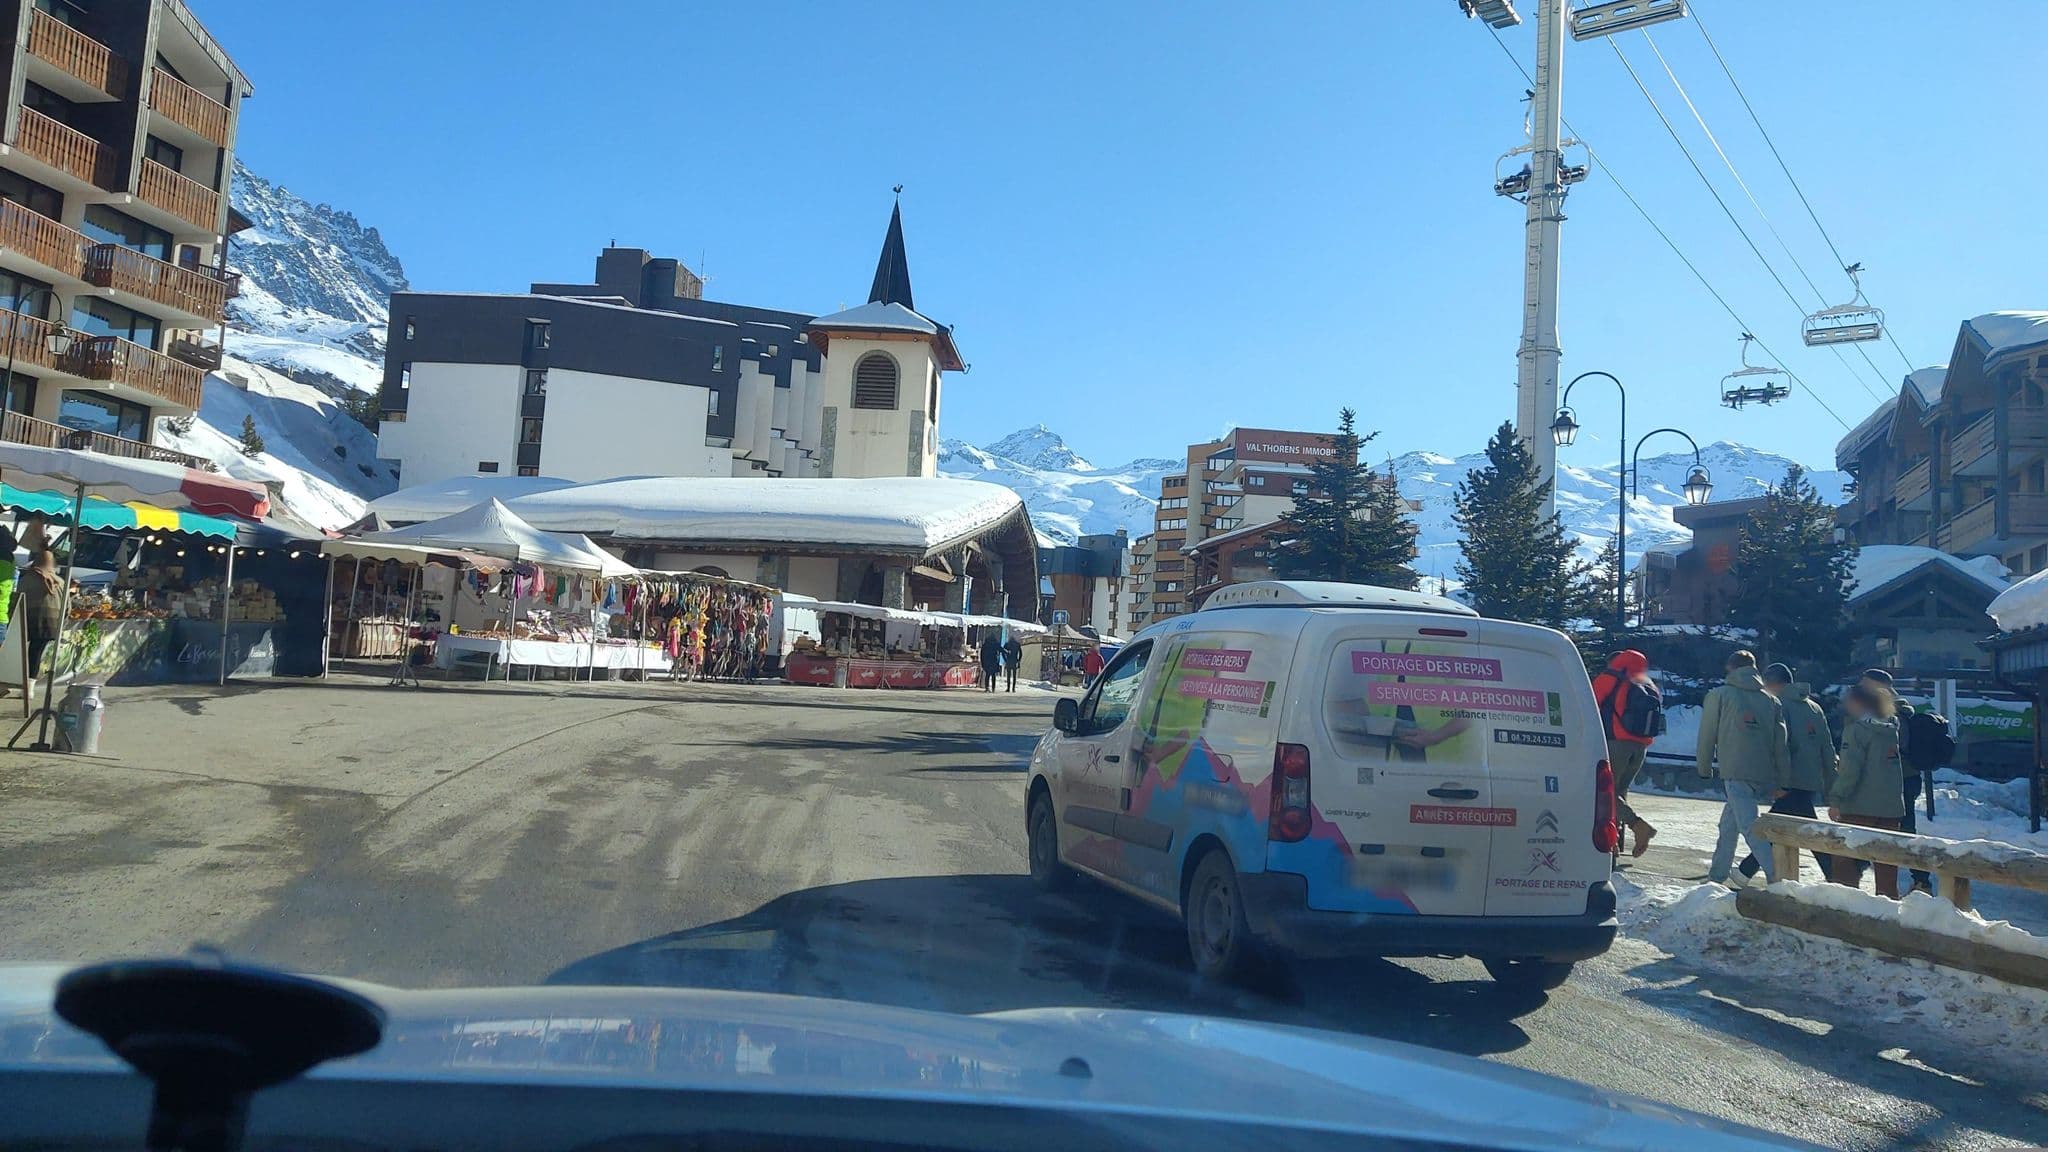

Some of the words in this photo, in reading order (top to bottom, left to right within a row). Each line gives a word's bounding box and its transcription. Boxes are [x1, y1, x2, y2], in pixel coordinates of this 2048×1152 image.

[1246, 443, 1261, 452] VAL
[1262, 444, 1300, 454] THORENS
[1211, 655, 1225, 667] DES
[1224, 655, 1245, 668] REPAS
[1362, 657, 1422, 672] PORTAGE
[1426, 660, 1452, 673] DES
[1454, 662, 1493, 676] REPAS
[1222, 683, 1260, 699] PERSONNE
[1376, 686, 1437, 701] SERVICES
[1440, 690, 1450, 702] A
[1453, 691, 1469, 703] LA
[1472, 692, 1537, 708] PERSONNE
[1440, 708, 1487, 720] assistance
[1488, 711, 1531, 724] technique
[1533, 715, 1546, 724] par
[1456, 810, 1512, 823] FRÉQUENTS
[1495, 878, 1540, 888] PORTAGE
[1542, 879, 1555, 889] DE
[1557, 880, 1587, 889] REPAS
